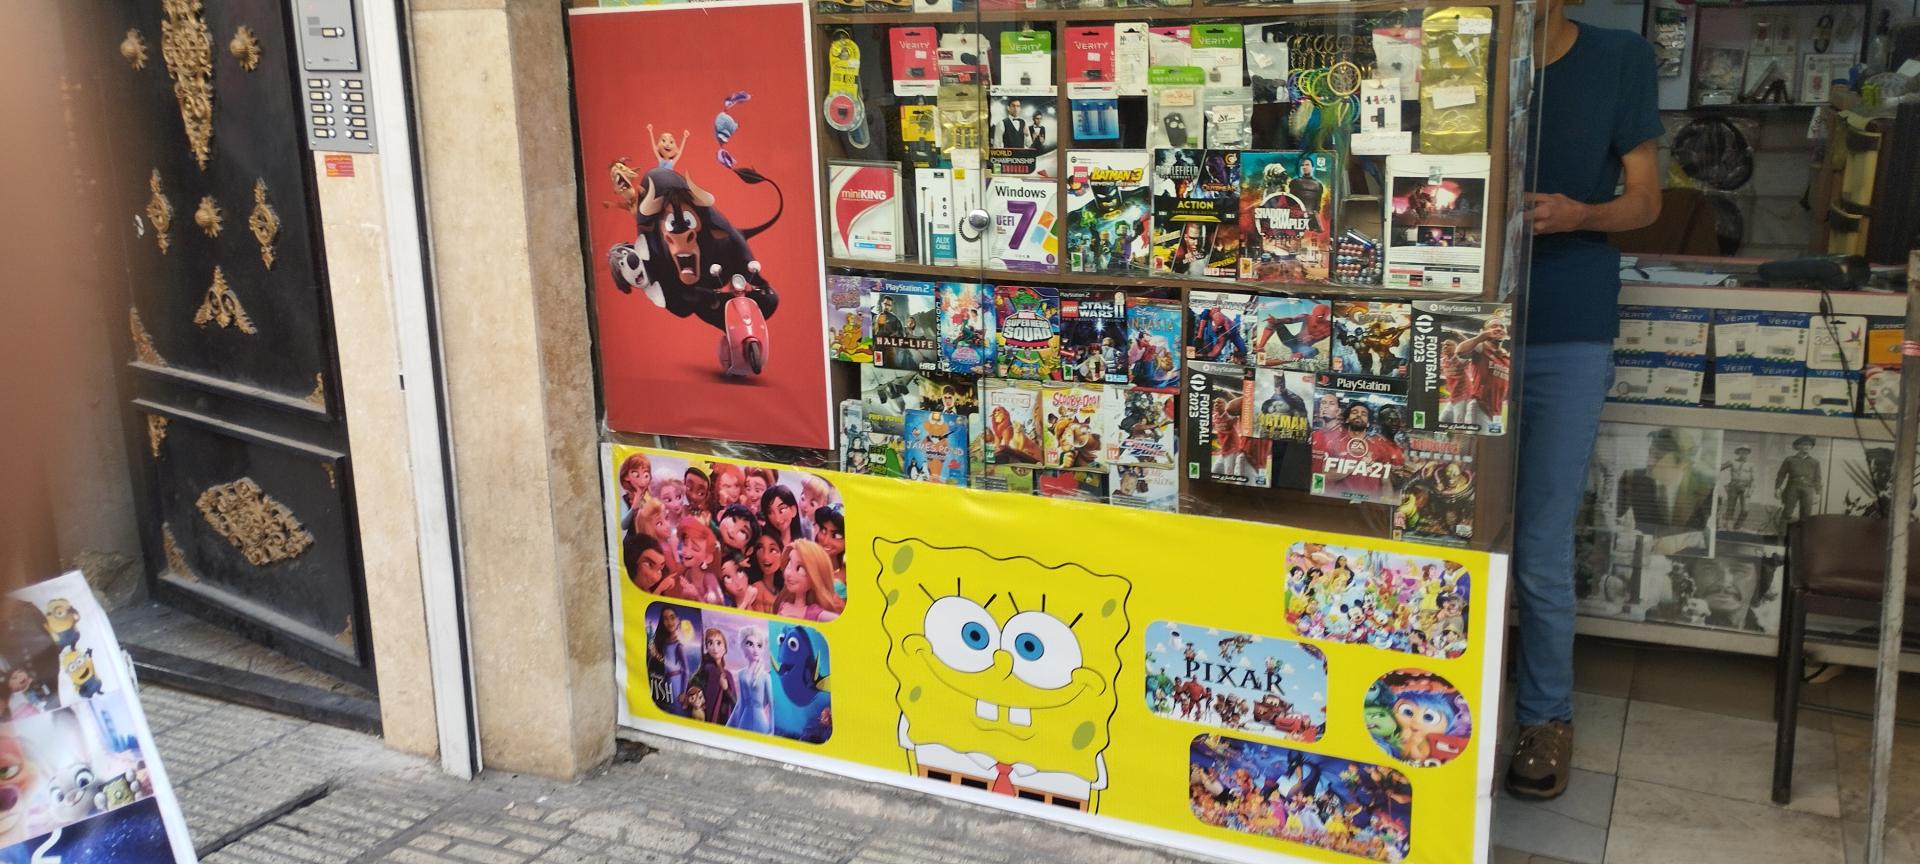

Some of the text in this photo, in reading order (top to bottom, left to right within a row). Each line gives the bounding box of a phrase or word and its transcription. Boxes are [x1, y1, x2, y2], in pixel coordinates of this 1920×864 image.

[899, 41, 930, 49] VERITY
[1075, 41, 1109, 49] VERITY
[1198, 36, 1234, 45] VERITY
[1008, 42, 1041, 51] VERITY
[1091, 167, 1131, 181] BATMAN
[1131, 168, 1144, 181] 3
[841, 189, 887, 200] miniKING
[995, 186, 1047, 199] Windows
[1177, 201, 1214, 209] ACTION
[1254, 207, 1291, 219] SHADOW
[996, 215, 1015, 226] UEFI
[1007, 200, 1038, 250] 7
[1269, 217, 1310, 231] COMPLEX
[885, 284, 930, 294] PlayStation 2
[1079, 301, 1114, 310] STAR
[1079, 309, 1113, 318] WARS
[1669, 312, 1705, 320] VERITY
[1723, 314, 1760, 322] VERITY
[1005, 319, 1030, 328] SUPER
[1768, 318, 1804, 326] VERITY
[1003, 326, 1052, 341] SQUAD
[1815, 335, 1832, 346] 32
[1414, 335, 1425, 363] 2023
[1425, 336, 1437, 392] FOOTBALL
[1664, 359, 1701, 368] VERITY
[1723, 364, 1753, 372] VERIT
[1762, 367, 1798, 375] VERITY
[1336, 378, 1391, 393] PlayStation
[1188, 392, 1199, 418] 2023
[1198, 393, 1210, 446] FOOTBALL
[1350, 442, 1366, 450] EA
[1323, 458, 1392, 479] FIFA 21
[1186, 655, 1286, 696] PIXAR
